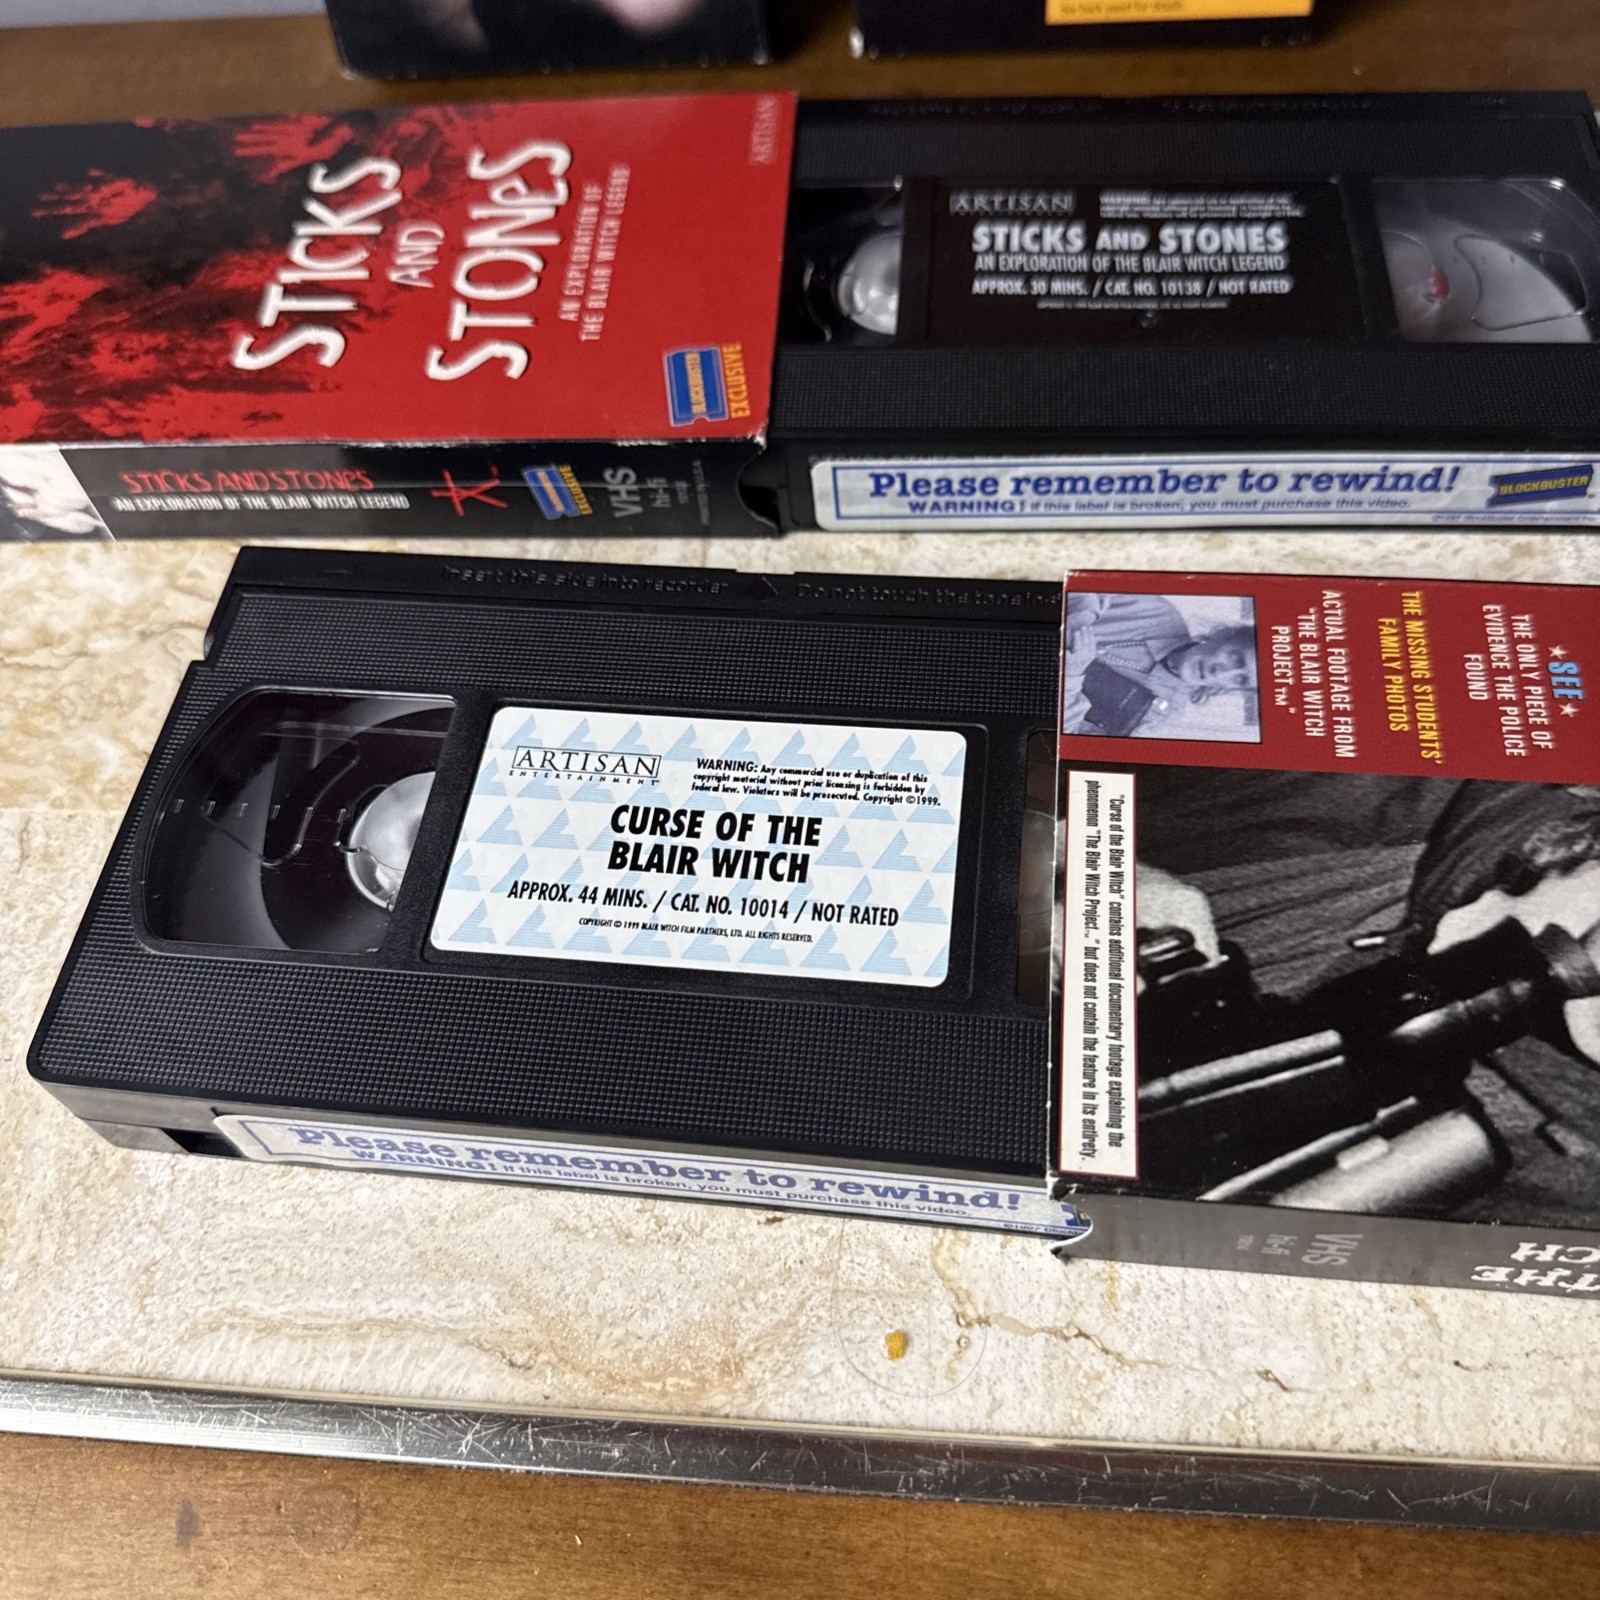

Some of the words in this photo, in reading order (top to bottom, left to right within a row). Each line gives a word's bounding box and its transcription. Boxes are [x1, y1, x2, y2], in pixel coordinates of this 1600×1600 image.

[605, 164, 630, 214] LEGEND
[388, 222, 445, 287] AND
[562, 202, 600, 295] EXPLORATION
[596, 216, 621, 261] WITCH
[972, 222, 1085, 252] STICKS
[1096, 228, 1149, 251] AND
[1159, 221, 1288, 254] STONES
[230, 157, 402, 370] STICKS
[974, 254, 995, 271] AN
[1000, 254, 1088, 272] EXPLORATION
[1092, 254, 1111, 272] OF
[1114, 254, 1139, 272] THE
[1143, 254, 1181, 272] BLAIR
[1186, 254, 1229, 272] WITCH
[1232, 253, 1287, 271] LEGEND
[586, 265, 613, 308] BLAIR
[972, 276, 1027, 295] APPROX.
[1050, 277, 1088, 296] MINS.
[1218, 277, 1245, 295] NOT
[1250, 275, 1292, 295] RATED
[559, 300, 581, 321] AN
[579, 312, 604, 341] THE
[722, 343, 750, 418] EXCLUSIVE
[120, 468, 213, 494] STICKS
[604, 467, 643, 517] VHS
[869, 472, 999, 498] Please
[1011, 469, 1227, 495] remember
[1238, 467, 1278, 493] to
[1288, 465, 1460, 493] rewind!
[1499, 474, 1589, 496] BLOCKBUSTER
[136, 494, 223, 511] EXPLORATION
[271, 494, 311, 510] BLAIR
[313, 494, 358, 510] WITCH
[359, 493, 410, 510] LEGEND
[908, 501, 1025, 514] WARNING!
[1074, 500, 1109, 512] label
[1261, 498, 1331, 511] purchase
[1336, 497, 1364, 508] this
[1368, 497, 1411, 509] video.
[1322, 589, 1344, 642] ACTUAL
[1401, 591, 1422, 616] THE
[1378, 617, 1401, 670] FAMILY
[1482, 604, 1511, 670] EVIDENCE
[1511, 614, 1532, 639] THE
[1299, 643, 1321, 684] BLAIR
[1405, 620, 1430, 679] MISSING
[1516, 643, 1540, 680] ONLY
[1327, 648, 1351, 711] FOOTAGE
[1463, 653, 1488, 700] FOUND
[1494, 675, 1516, 701] THE
[1548, 660, 1583, 700] SEE
[1303, 690, 1325, 736] WITCH
[1384, 675, 1409, 731] PHOTOS
[1523, 685, 1549, 725] PIECE
[1333, 716, 1356, 758] FROM
[1499, 706, 1526, 757] POLICE
[1531, 731, 1553, 749] OF
[509, 770, 657, 786] ENTERTAINMENT
[515, 749, 657, 776] ARTISAN
[697, 758, 758, 773] WARNING:
[761, 765, 776, 775] Any
[779, 767, 824, 777] commercial
[854, 769, 898, 781] duplication
[901, 773, 910, 782] of
[913, 773, 928, 783] this
[691, 782, 719, 792] federal
[722, 784, 740, 794] law.
[743, 786, 780, 796] Violators
[782, 788, 798, 797] will
[800, 789, 810, 798] be
[812, 791, 860, 801] prosecuted.
[863, 793, 903, 805] Copyright
[906, 795, 941, 806] ©1999.
[693, 773, 730, 783] copyright
[733, 775, 767, 784] material
[769, 777, 801, 786] without
[803, 779, 824, 788] prior
[826, 780, 861, 791] licensing
[873, 782, 912, 792] forbidden
[915, 784, 925, 795] by
[1084, 780, 1101, 827] phenomenon
[610, 804, 705, 839] CURSE
[715, 811, 755, 842] OF
[767, 815, 823, 847] THE
[1109, 834, 1124, 846] the
[607, 840, 699, 876] BLAIR
[711, 847, 810, 883] WITCH
[1086, 851, 1100, 871] Blair
[1109, 848, 1124, 868] Blair
[1085, 873, 1100, 896] Witch
[507, 880, 573, 903] APPROX.
[578, 885, 599, 904] 44
[602, 887, 648, 909] MINS.
[652, 890, 667, 913] /
[671, 892, 700, 913] CAT.
[705, 895, 732, 915] NO.
[740, 897, 789, 919] 10014
[793, 900, 808, 923] /
[811, 902, 845, 923] NOT
[849, 905, 899, 927] RATED
[1109, 901, 1124, 937] contains
[579, 917, 612, 927] COPYRIGHT
[623, 920, 639, 929] 1999
[641, 922, 659, 931] BLAIR
[660, 923, 680, 932] WITCH
[680, 925, 695, 933] FILM
[696, 926, 729, 937] PARTNERS,
[730, 928, 743, 937] LTD.
[745, 930, 756, 938] ALL
[758, 930, 780, 940] RIGHTS
[781, 932, 813, 942] RESERVED.
[1084, 946, 1099, 960] but
[1109, 939, 1124, 980] additional
[1084, 962, 1099, 983] does
[1084, 985, 1099, 999] not
[1083, 1002, 1099, 1034] contain
[1106, 982, 1124, 1041] documentary
[1083, 1037, 1099, 1051] the
[1106, 1044, 1124, 1078] footage
[1082, 1054, 1099, 1088] feature
[1082, 1103, 1099, 1116] its
[1106, 1080, 1125, 1129] explaining
[1079, 1118, 1099, 1161] entirety.
[1109, 1131, 1125, 1148] the
[287, 1126, 457, 1159] Please
[466, 1145, 731, 1183] remember
[743, 1168, 797, 1189] to
[810, 1177, 1021, 1211] rewind!
[352, 1149, 497, 1172] WARNING!
[515, 1166, 553, 1176] this
[557, 1168, 600, 1180] label
[624, 1175, 692, 1190] broken,
[697, 1183, 731, 1195] you
[736, 1187, 781, 1198] must
[785, 1191, 871, 1207] purchase
[876, 1198, 914, 1210] this
[916, 1203, 971, 1216] video.
[1301, 1234, 1363, 1265] VHS
